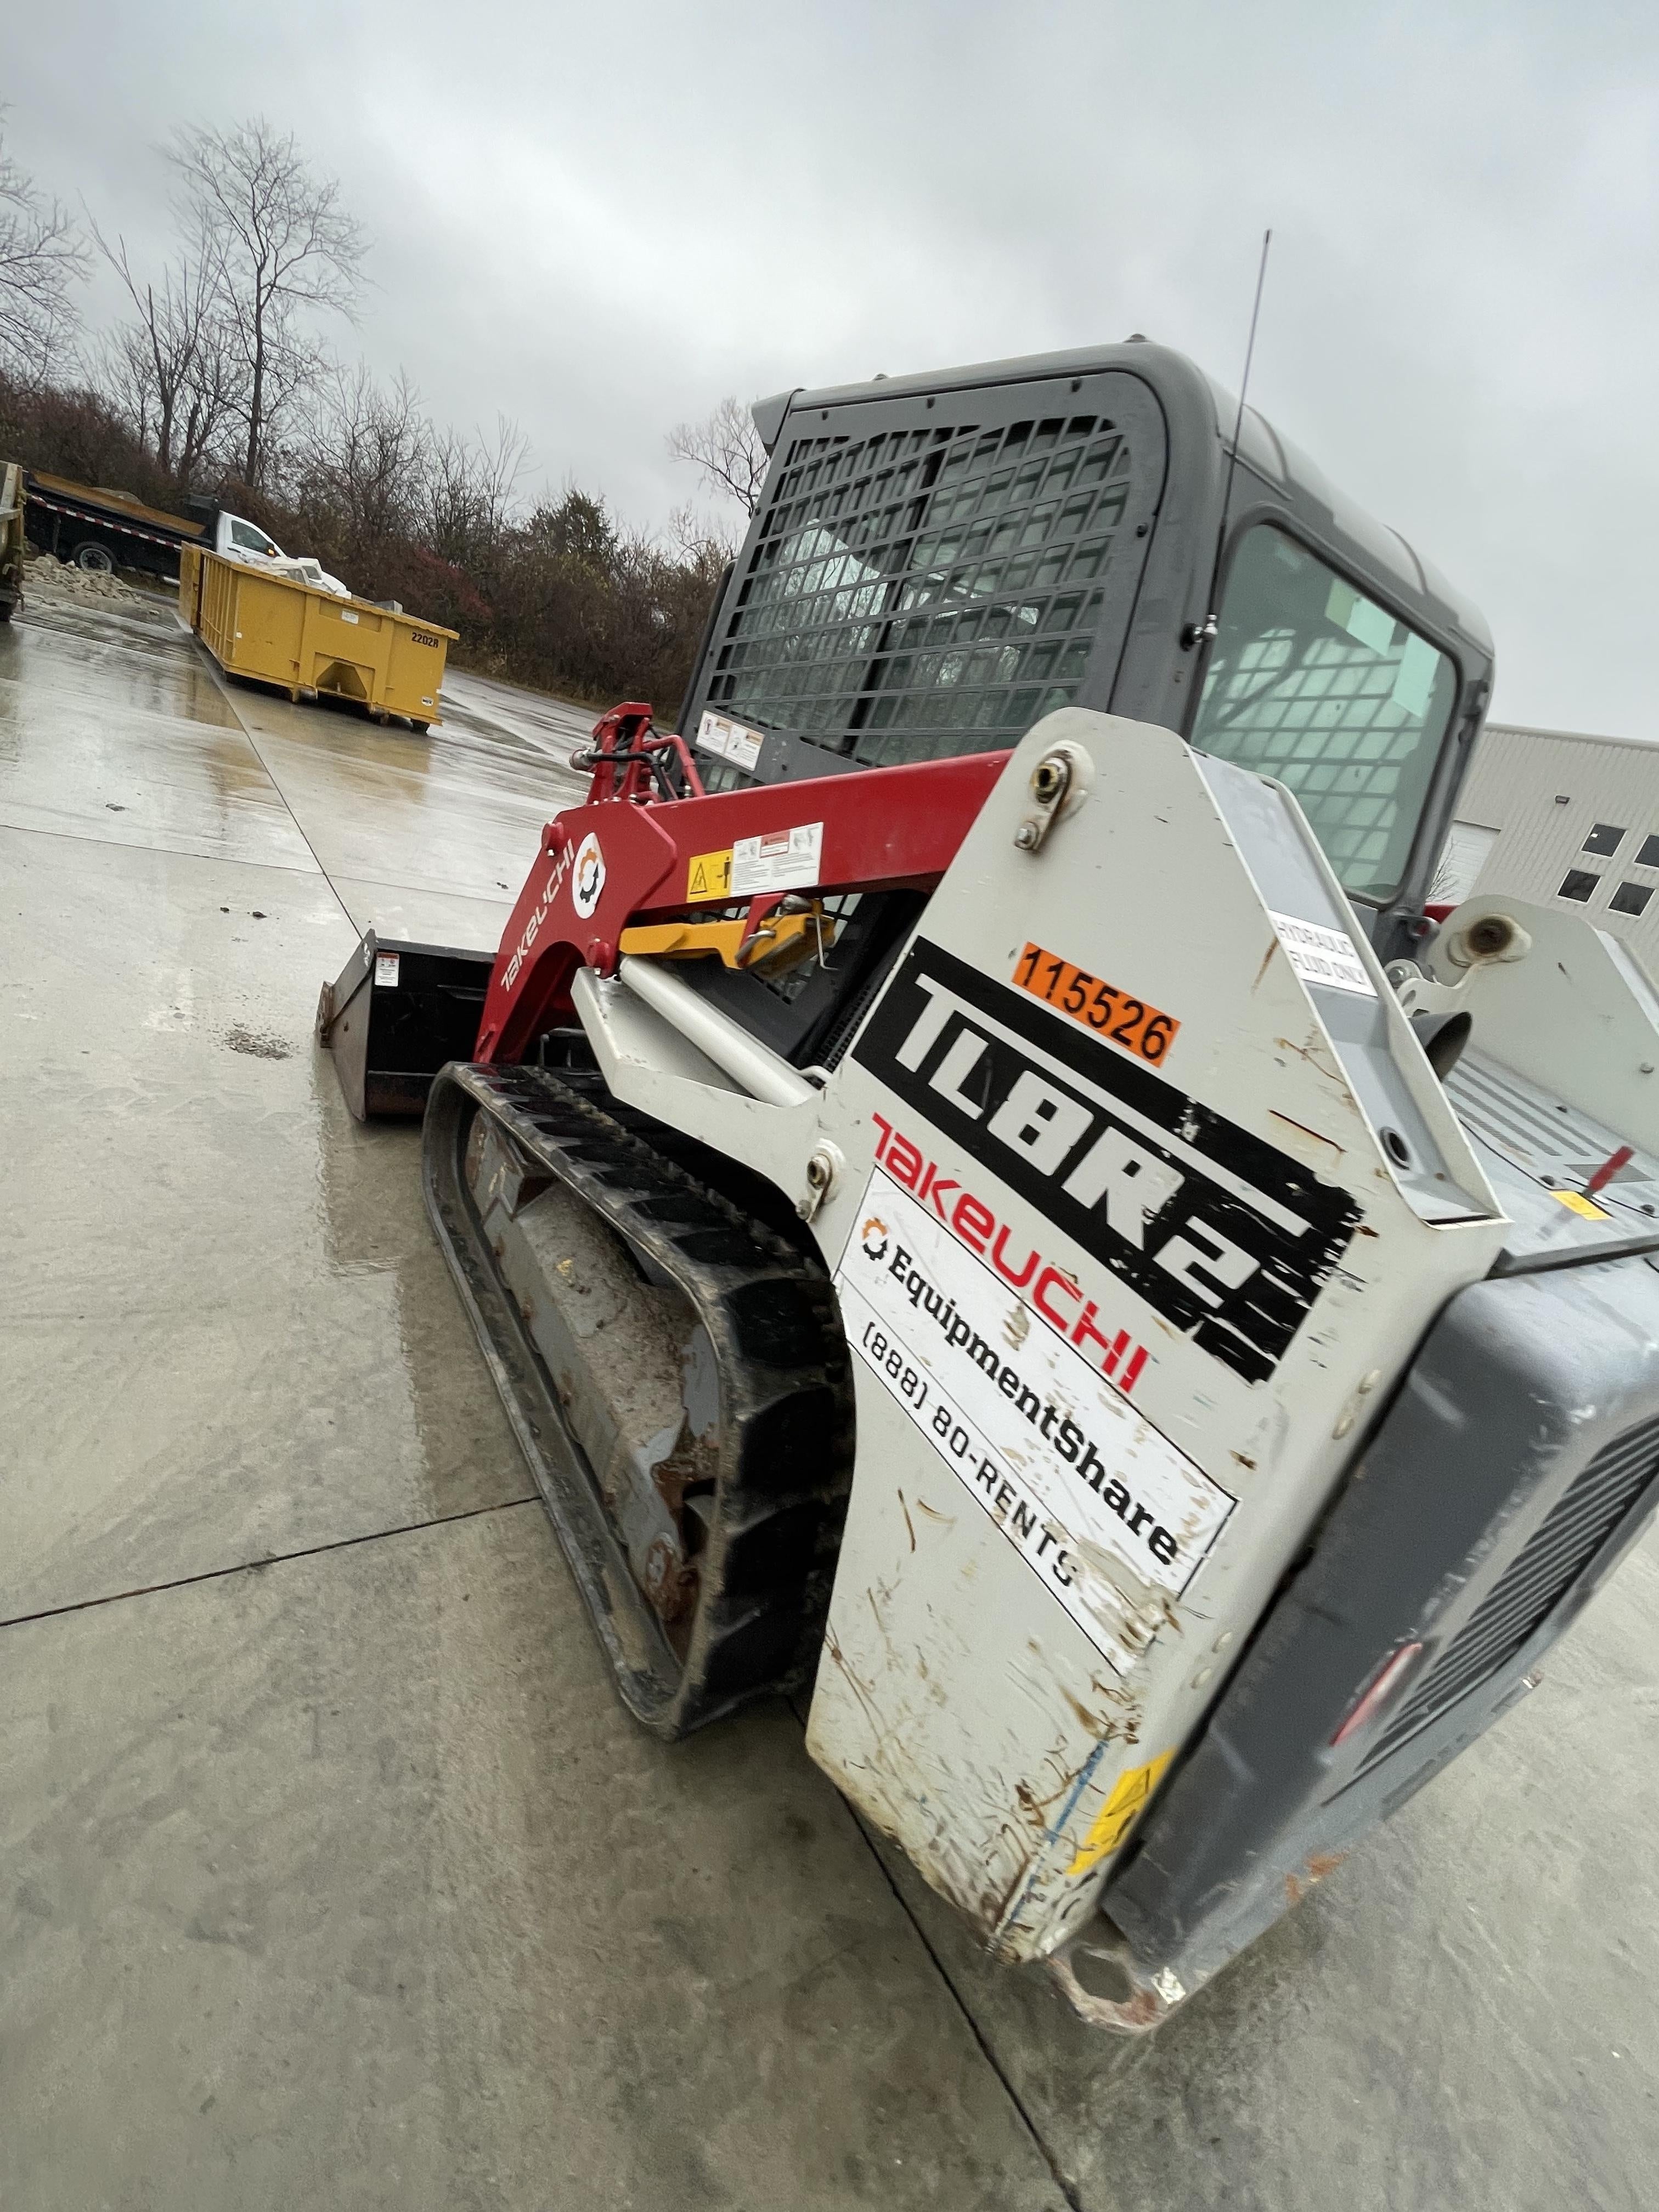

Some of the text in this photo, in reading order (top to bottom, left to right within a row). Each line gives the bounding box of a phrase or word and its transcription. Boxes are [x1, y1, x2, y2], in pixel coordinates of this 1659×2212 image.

[895, 973, 1312, 1308] TL8R2
[1022, 948, 1173, 1061] 115526
[862, 1321, 1080, 1587] (888) 80-RENTS
[888, 1246, 1179, 1565] EquipmentShare
